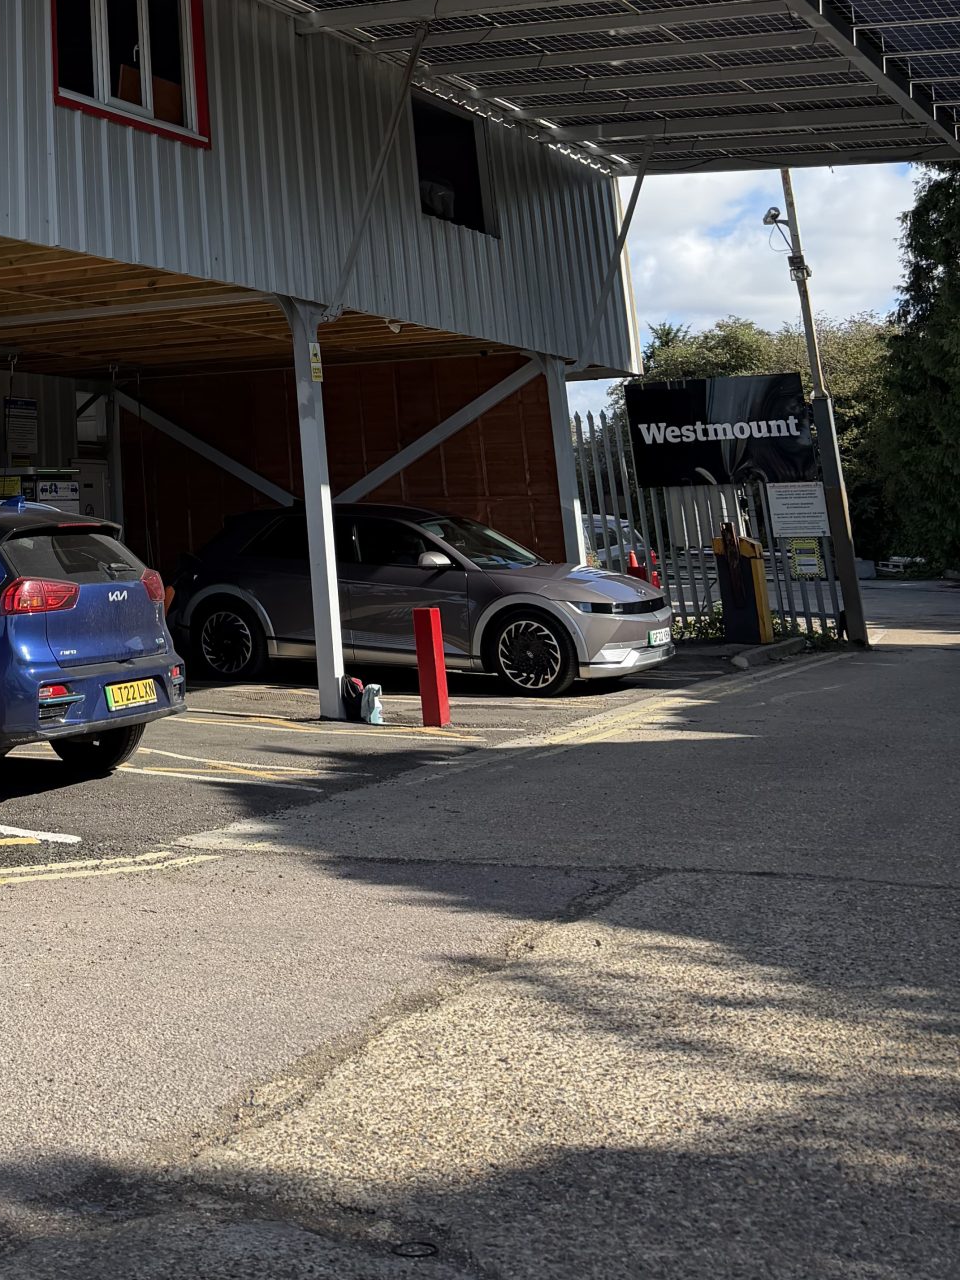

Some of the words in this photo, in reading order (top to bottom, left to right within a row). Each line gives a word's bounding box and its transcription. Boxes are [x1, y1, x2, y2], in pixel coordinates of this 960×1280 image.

[638, 415, 801, 445] Westmount
[108, 590, 128, 602] KIA
[111, 684, 136, 704] LT22
[138, 680, 156, 699] LXN
